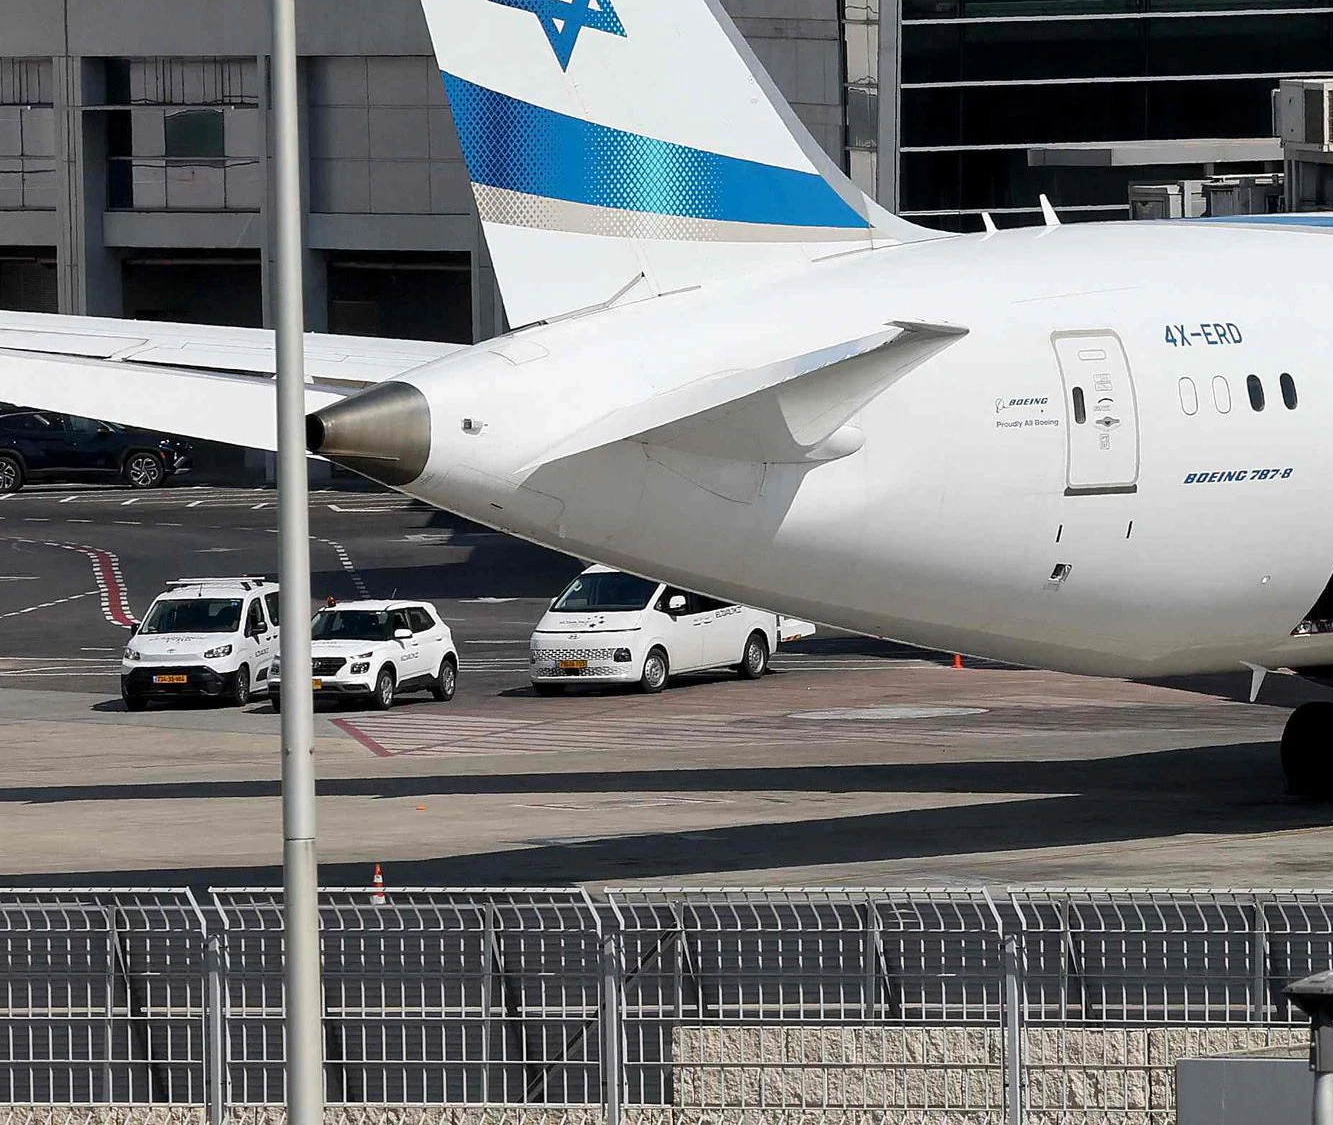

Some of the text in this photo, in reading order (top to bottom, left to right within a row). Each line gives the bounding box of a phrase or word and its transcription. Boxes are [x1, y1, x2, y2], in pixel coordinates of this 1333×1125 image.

[1165, 323, 1243, 347] 4X-ERD
[1008, 397, 1049, 406] BOEING
[996, 420, 1023, 428] Proudly
[1034, 419, 1060, 427] Boeing
[1183, 470, 1248, 484] BOEING
